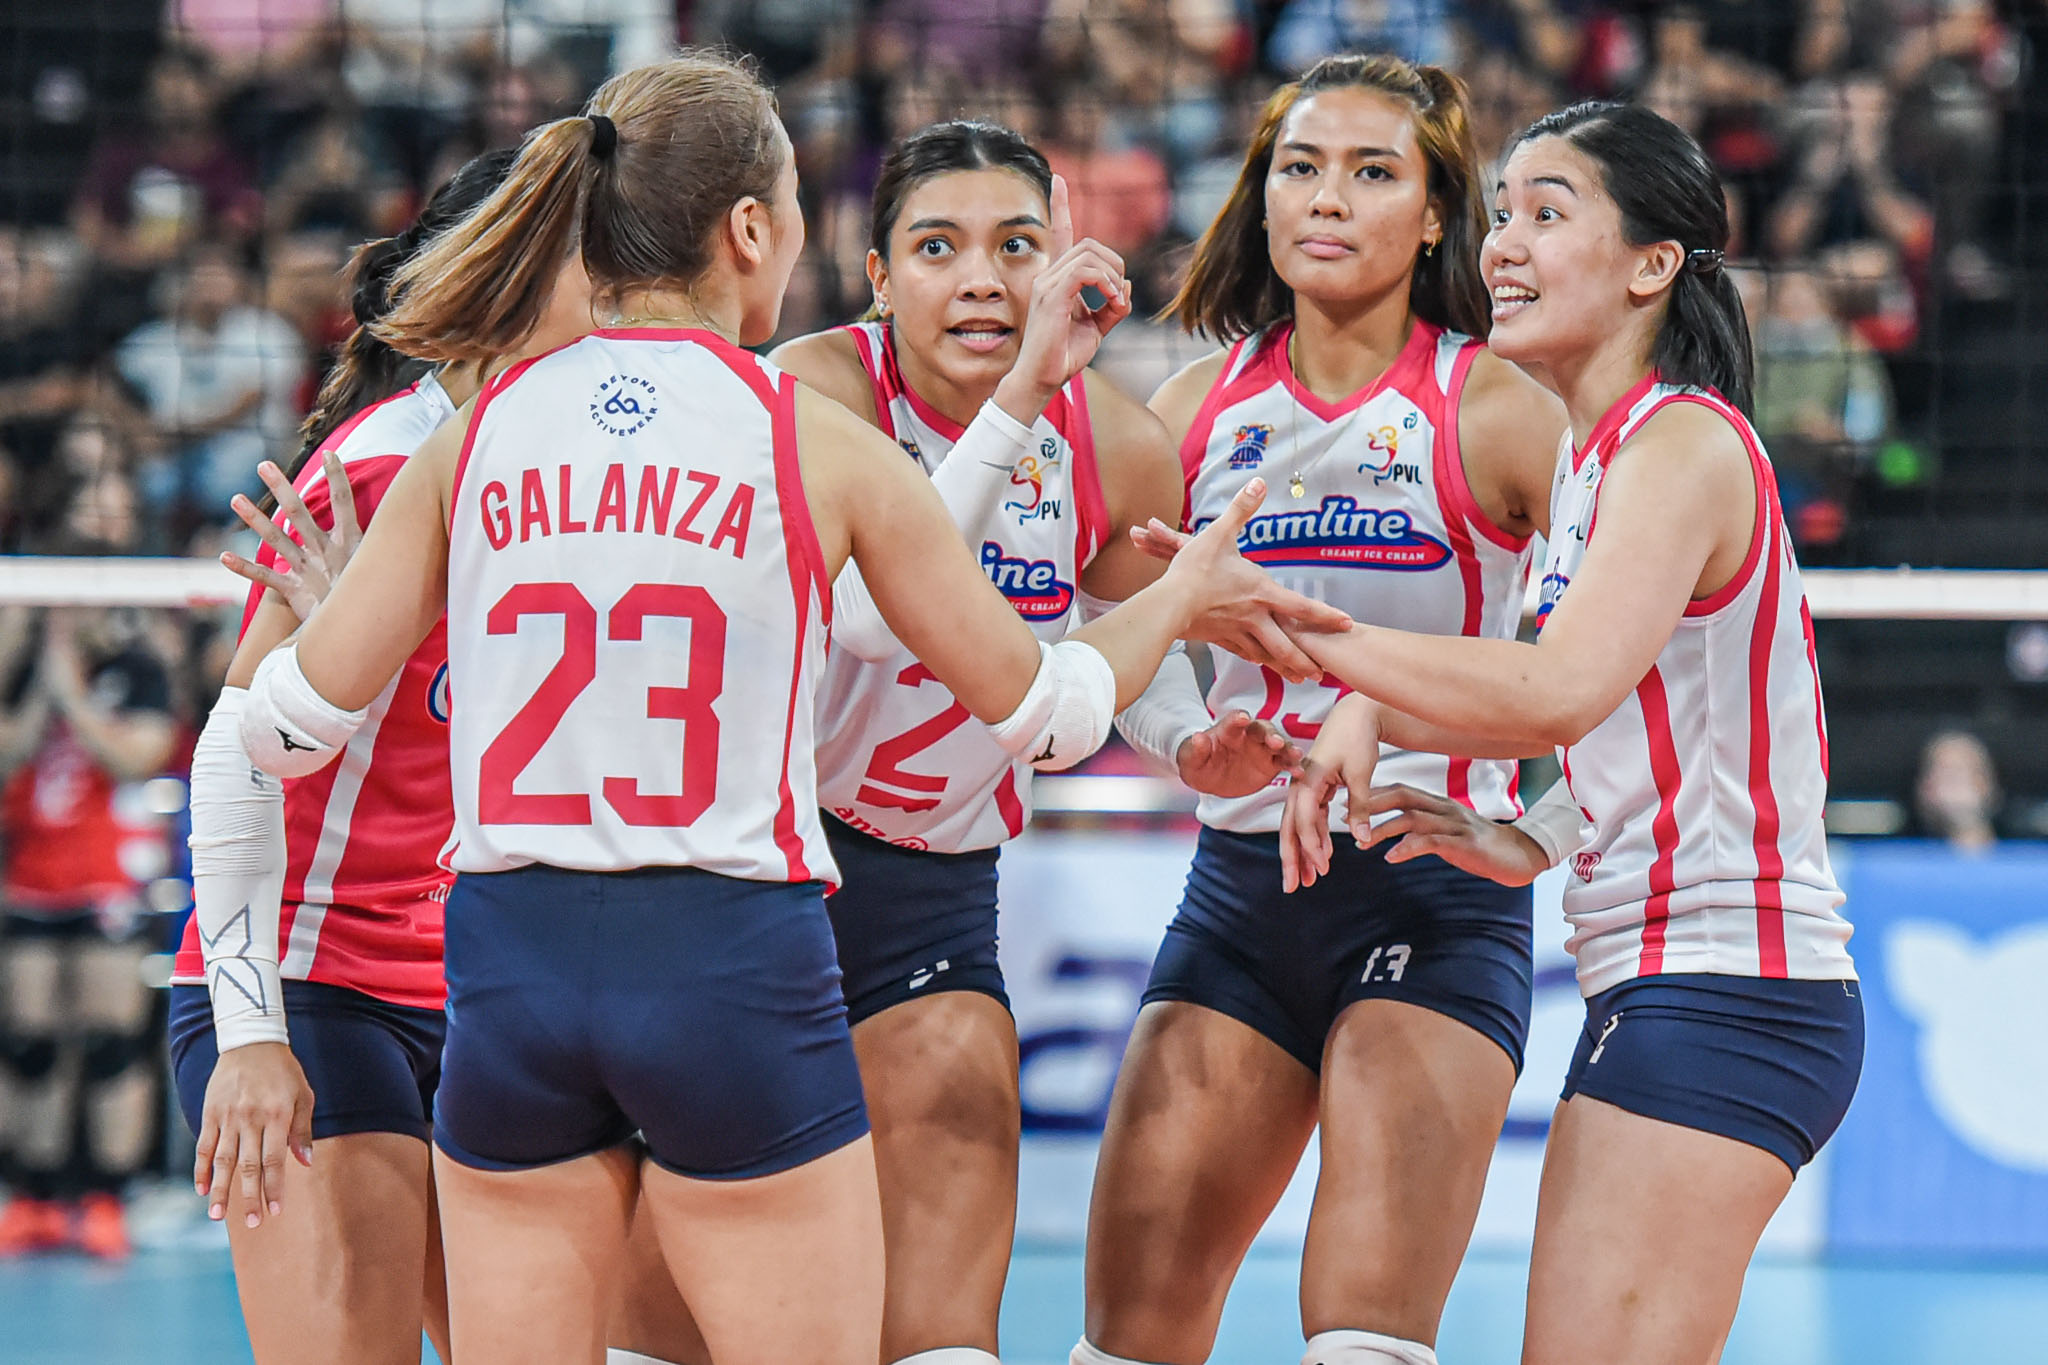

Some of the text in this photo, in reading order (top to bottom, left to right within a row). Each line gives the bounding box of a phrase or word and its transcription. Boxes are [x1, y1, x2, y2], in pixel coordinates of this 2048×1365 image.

[600, 374, 656, 394] BEYOND
[590, 403, 658, 436] ACTIVEWEAR
[1393, 463, 1422, 485] PVL
[480, 463, 755, 560] GALANZA
[1364, 549, 1383, 559] ICE
[1386, 551, 1425, 561] CREAM
[478, 582, 728, 828] 23
